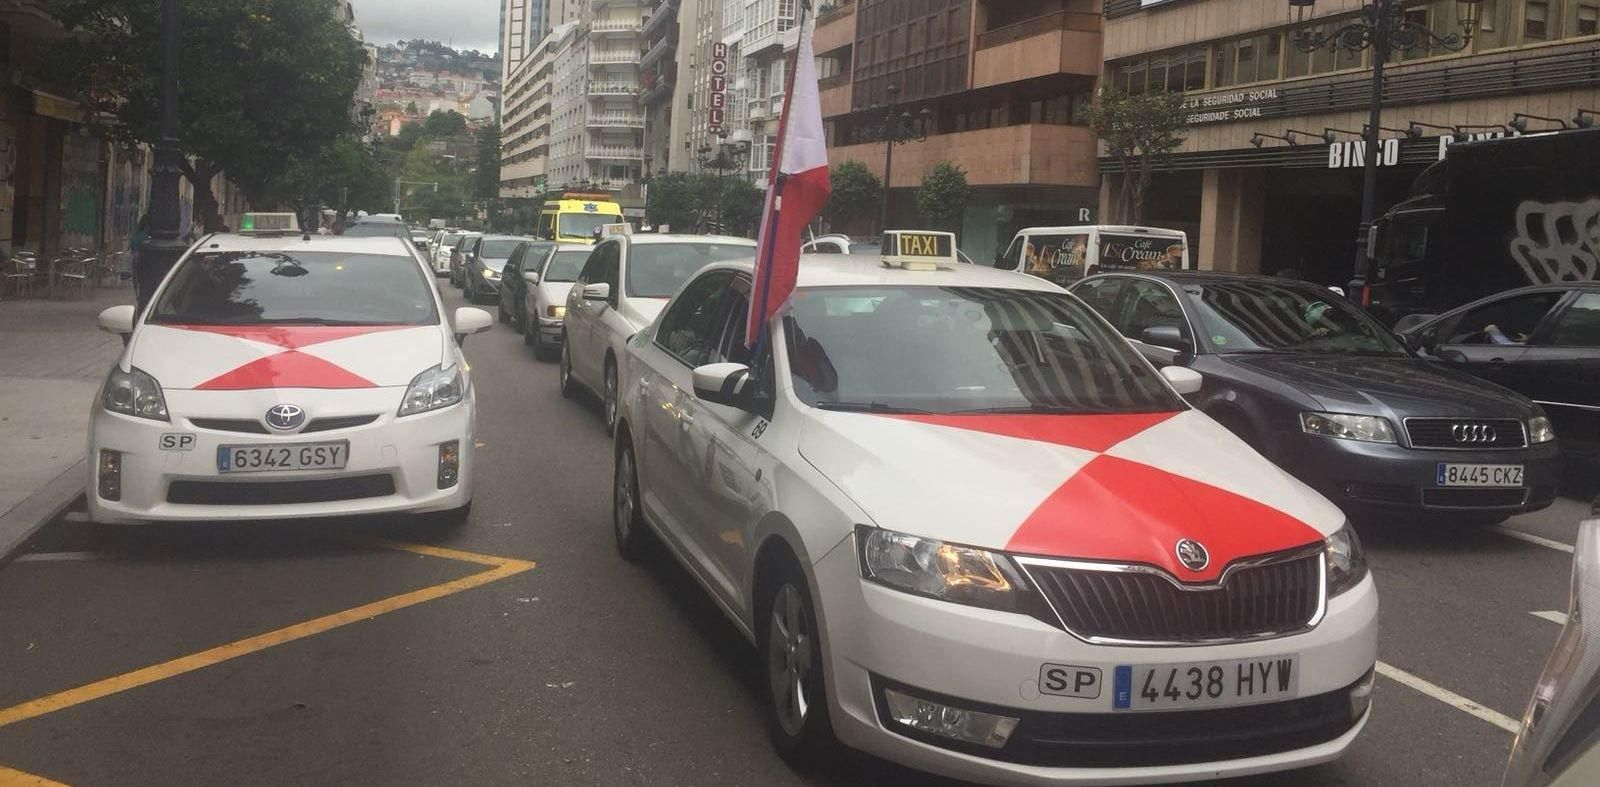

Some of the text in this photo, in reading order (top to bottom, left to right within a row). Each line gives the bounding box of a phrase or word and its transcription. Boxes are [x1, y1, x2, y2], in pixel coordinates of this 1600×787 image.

[712, 43, 726, 124] HOTEL
[1203, 92, 1244, 107] SEGURIDAD
[1249, 88, 1278, 101] SOCIAL
[1186, 107, 1262, 124] SEGURIDADE SOCIAL
[1079, 207, 1090, 222] R
[901, 234, 937, 255] TAXI
[1121, 246, 1162, 262] Cream
[162, 434, 193, 449] SP
[234, 446, 341, 468] 6342 GSY
[1448, 466, 1523, 484] 8445 CKZ
[1045, 667, 1097, 693] SP
[1140, 665, 1224, 703] 4438
[1236, 658, 1293, 697] HYW
